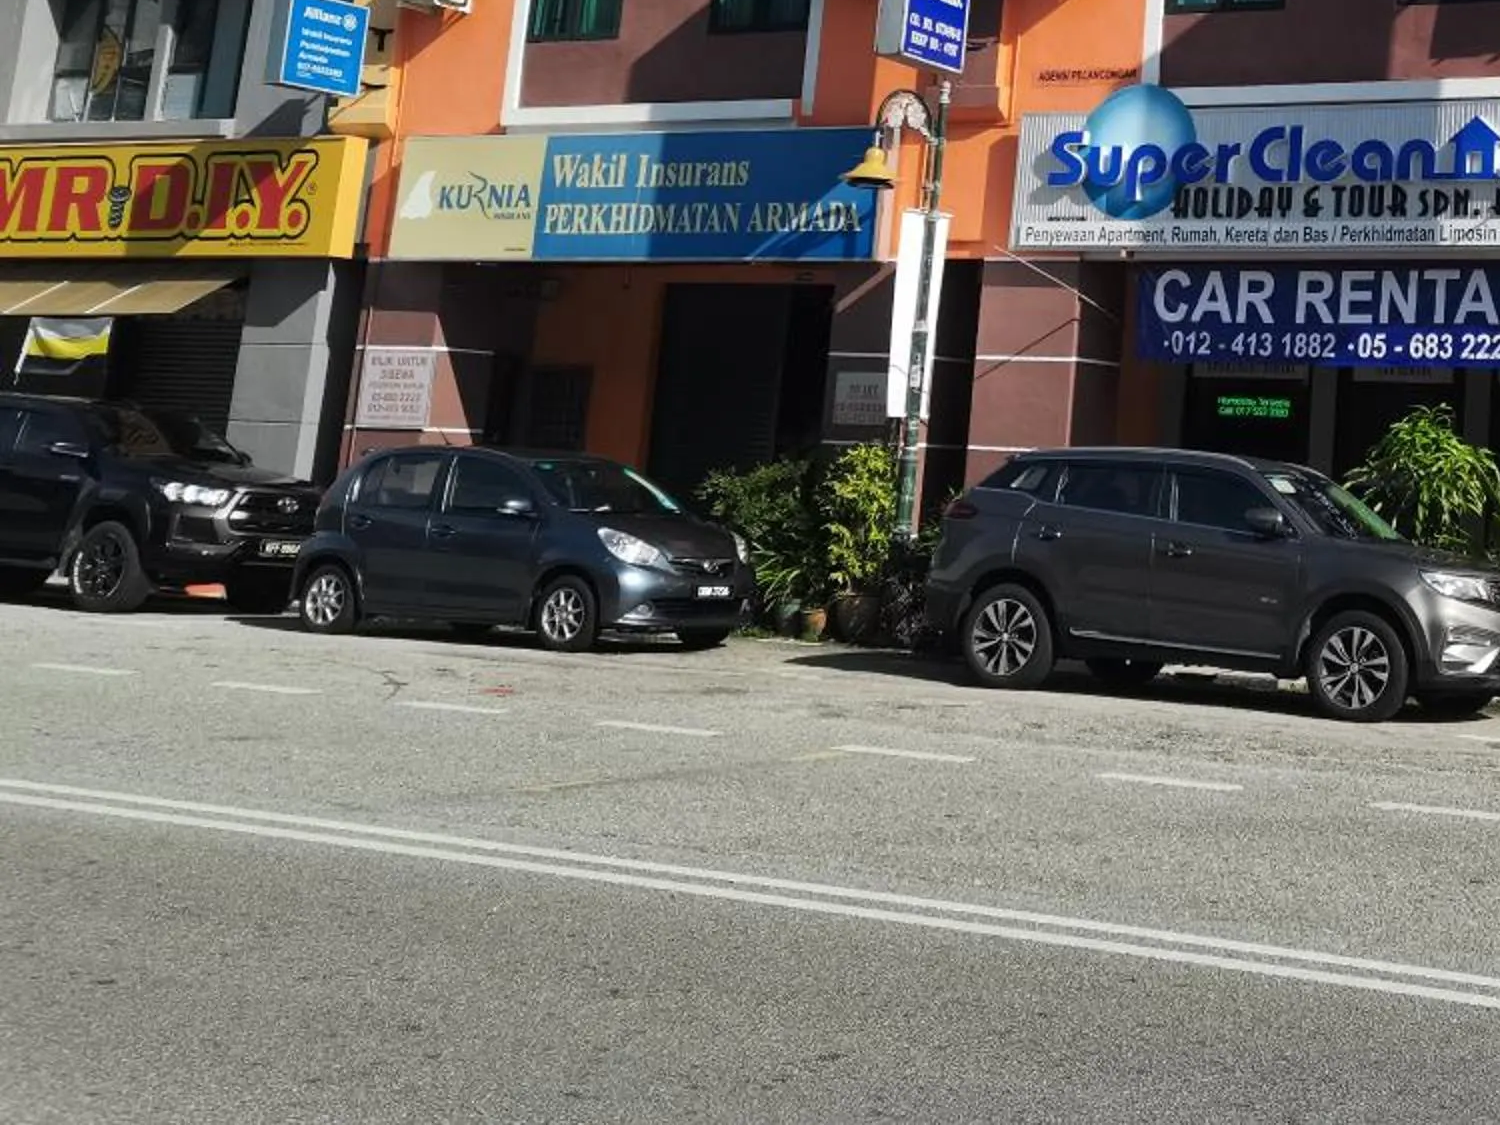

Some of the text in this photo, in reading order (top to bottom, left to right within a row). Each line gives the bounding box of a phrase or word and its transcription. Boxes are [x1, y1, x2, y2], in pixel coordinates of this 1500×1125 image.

[303, 6, 343, 26] Allianz
[552, 153, 751, 188] Wakil Insurans
[438, 170, 531, 220] KURNIA
[1170, 185, 1294, 219] HOLIDAY
[1332, 185, 1410, 218] TOUR
[1418, 185, 1482, 218] SDN.
[543, 200, 862, 235] PERKHIDMATAN ARMADA
[1025, 226, 1095, 246] Penyewaan
[1098, 226, 1167, 245] Apartment,
[1171, 226, 1221, 245] Rumah,
[1225, 226, 1268, 243] Kereta
[1273, 227, 1299, 243] dan
[1303, 226, 1329, 243] Bas
[1341, 224, 1435, 242] Perkhidmatan
[1439, 224, 1497, 245] Limosin
[1152, 268, 1276, 327] CAR
[1231, 331, 1273, 358] 413
[1281, 332, 1336, 359] 1882
[1409, 332, 1453, 359] 683
